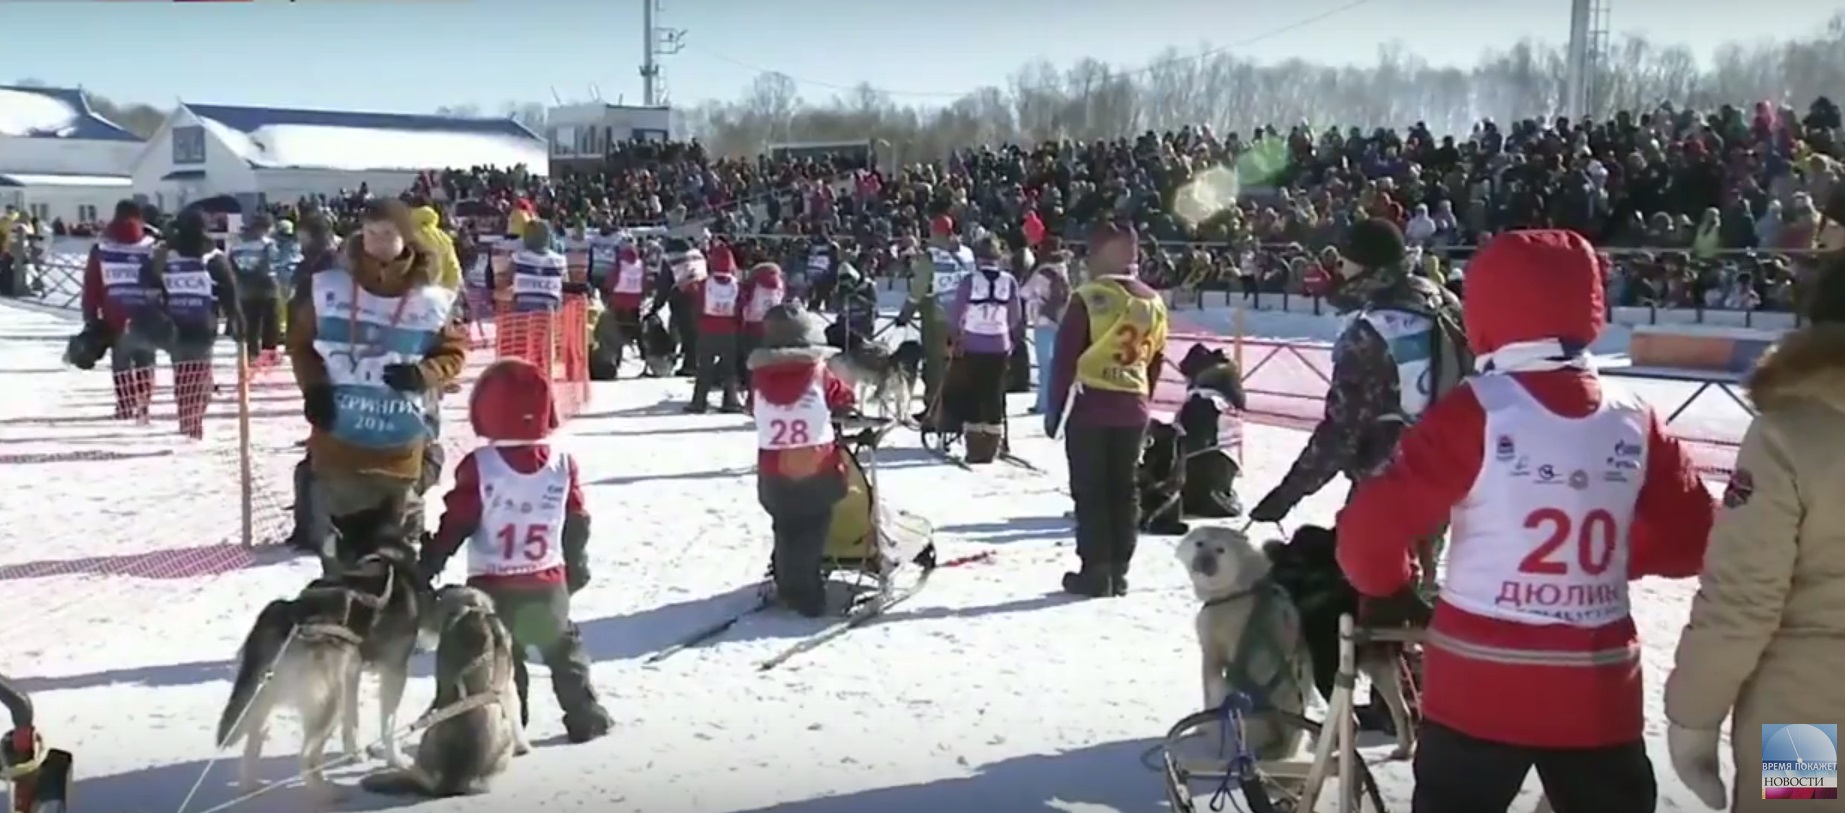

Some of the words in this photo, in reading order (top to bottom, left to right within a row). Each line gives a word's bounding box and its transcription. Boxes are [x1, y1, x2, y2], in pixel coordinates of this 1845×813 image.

[769, 419, 809, 445] 28
[497, 523, 548, 560] 15
[1517, 507, 1617, 575] 20
